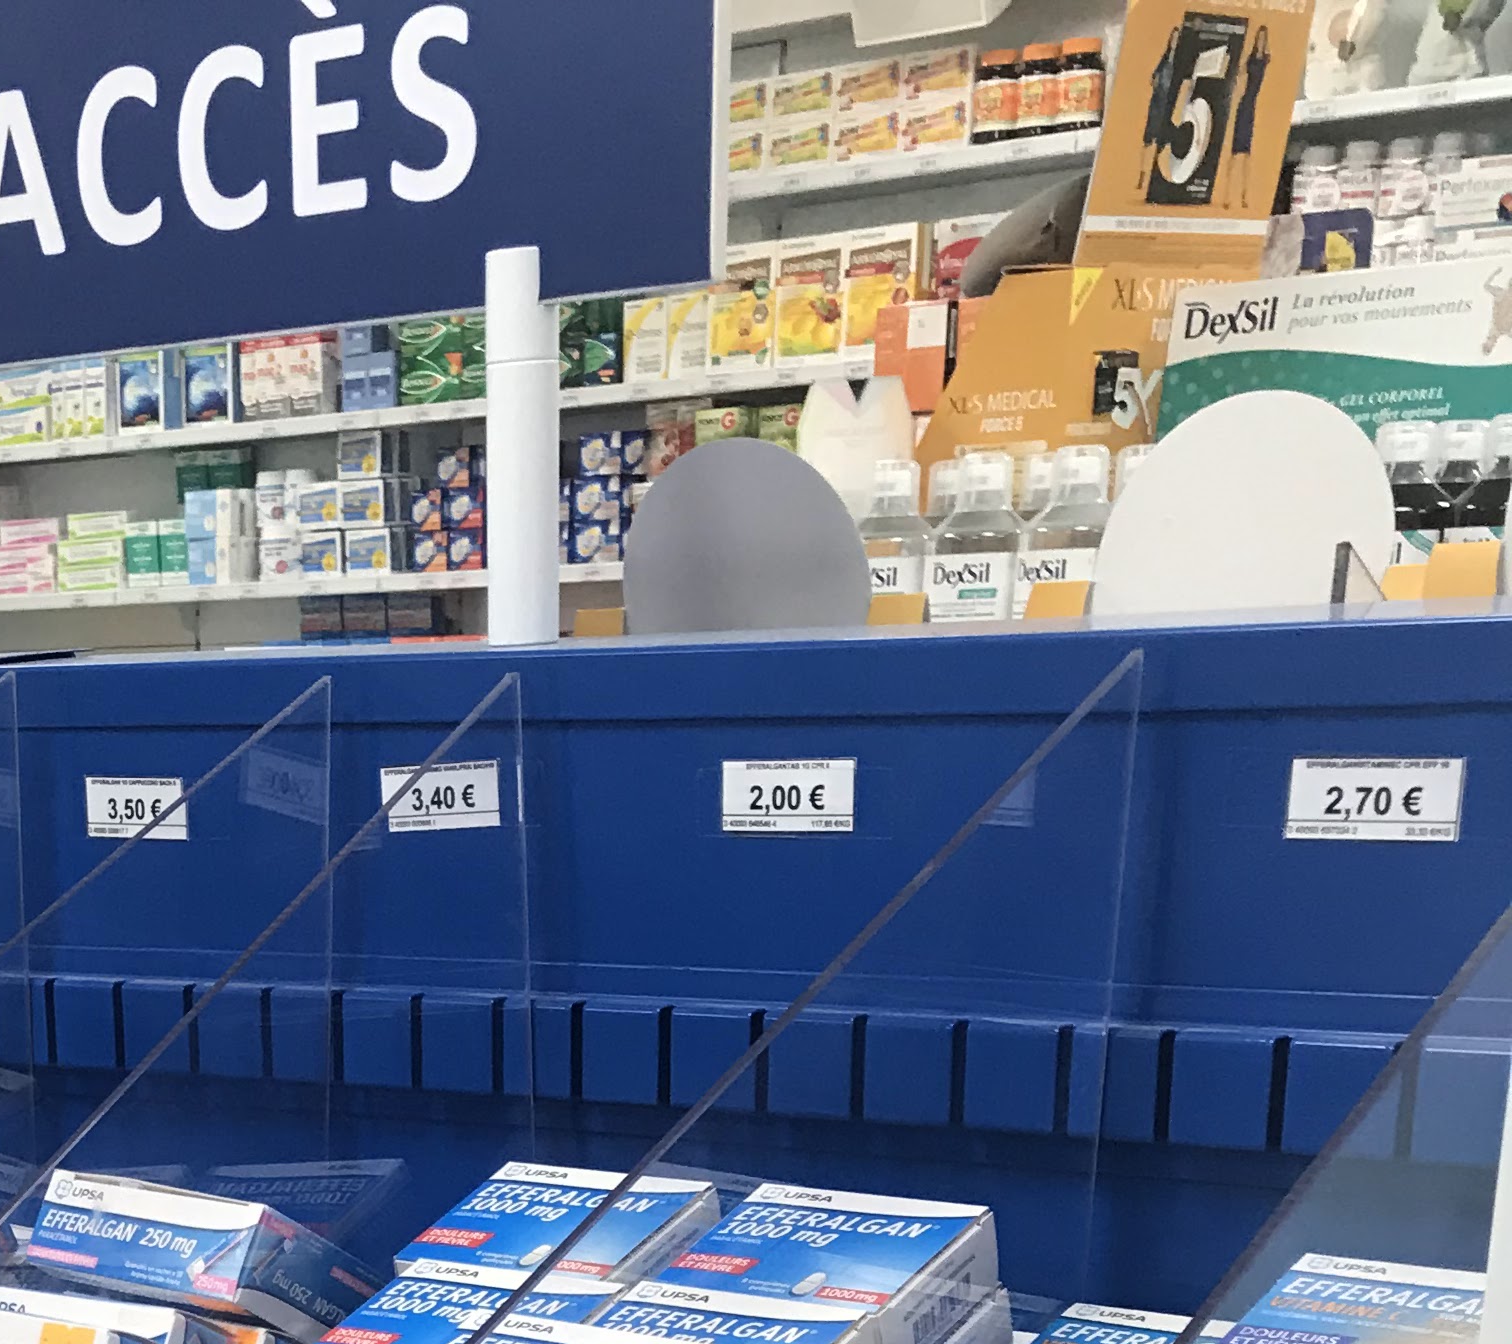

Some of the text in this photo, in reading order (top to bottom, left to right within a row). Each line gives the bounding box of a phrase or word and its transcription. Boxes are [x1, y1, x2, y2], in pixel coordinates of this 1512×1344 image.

[1320, 283, 1415, 307] révolution
[1184, 295, 1279, 344] DexSil
[933, 562, 991, 590] DexSil
[108, 798, 161, 824] 3,50 €
[412, 784, 475, 815] 3,40 €
[750, 785, 825, 815] 2,00 €
[1324, 786, 1424, 821] 2,70 €
[526, 1168, 569, 1181] UPSA
[468, 1199, 563, 1221] 1000 mg
[783, 1191, 833, 1205] UPSA
[43, 1209, 198, 1258] EFFERALGAN 250 mg
[718, 1221, 839, 1248] 1000 mg
[733, 1206, 942, 1239] EFFERALGAN
[685, 1254, 754, 1270] DOULEURS
[1333, 1261, 1388, 1276] UPSA
[661, 1289, 710, 1303] UPSA
[623, 1306, 819, 1343] EFFERALGAN
